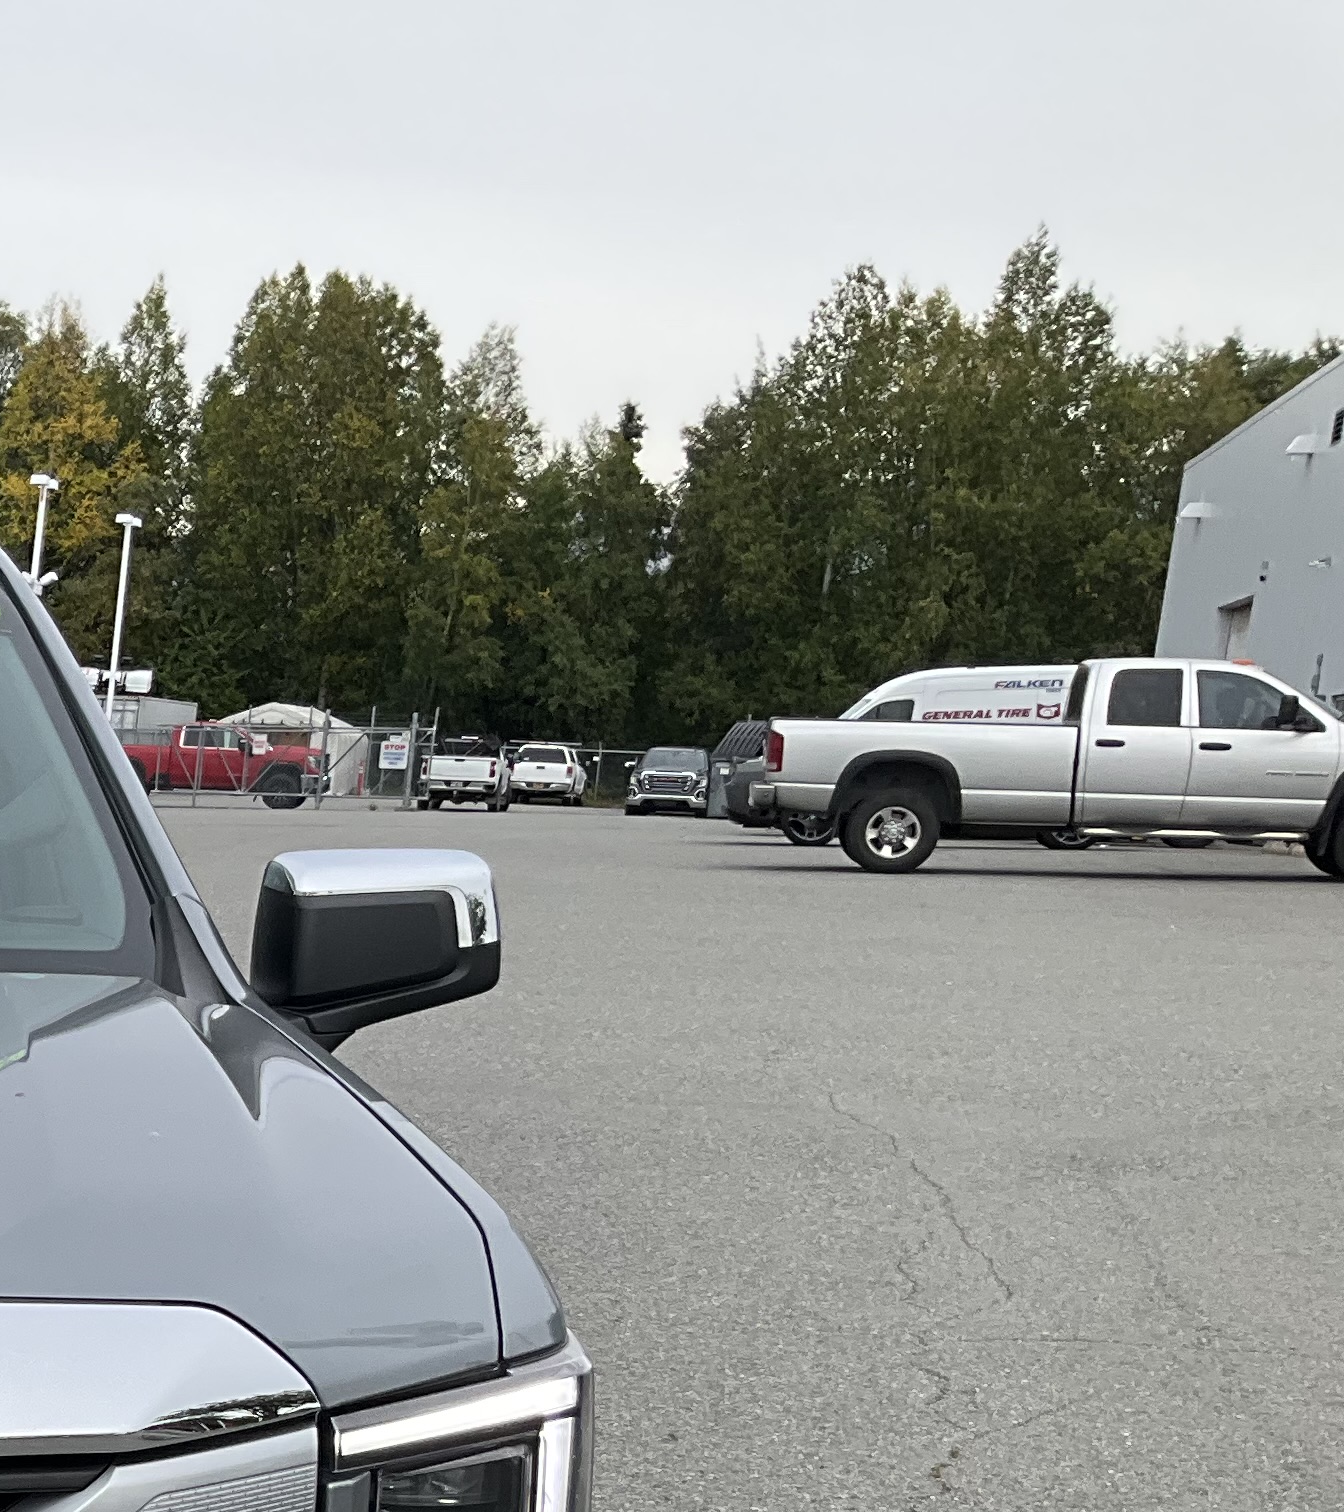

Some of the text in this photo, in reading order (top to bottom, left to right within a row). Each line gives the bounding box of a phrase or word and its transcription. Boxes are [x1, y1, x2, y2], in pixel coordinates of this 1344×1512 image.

[994, 679, 1064, 689] FALKEN
[921, 707, 1033, 721] GENERAL TIRE
[384, 743, 406, 751] STOP
